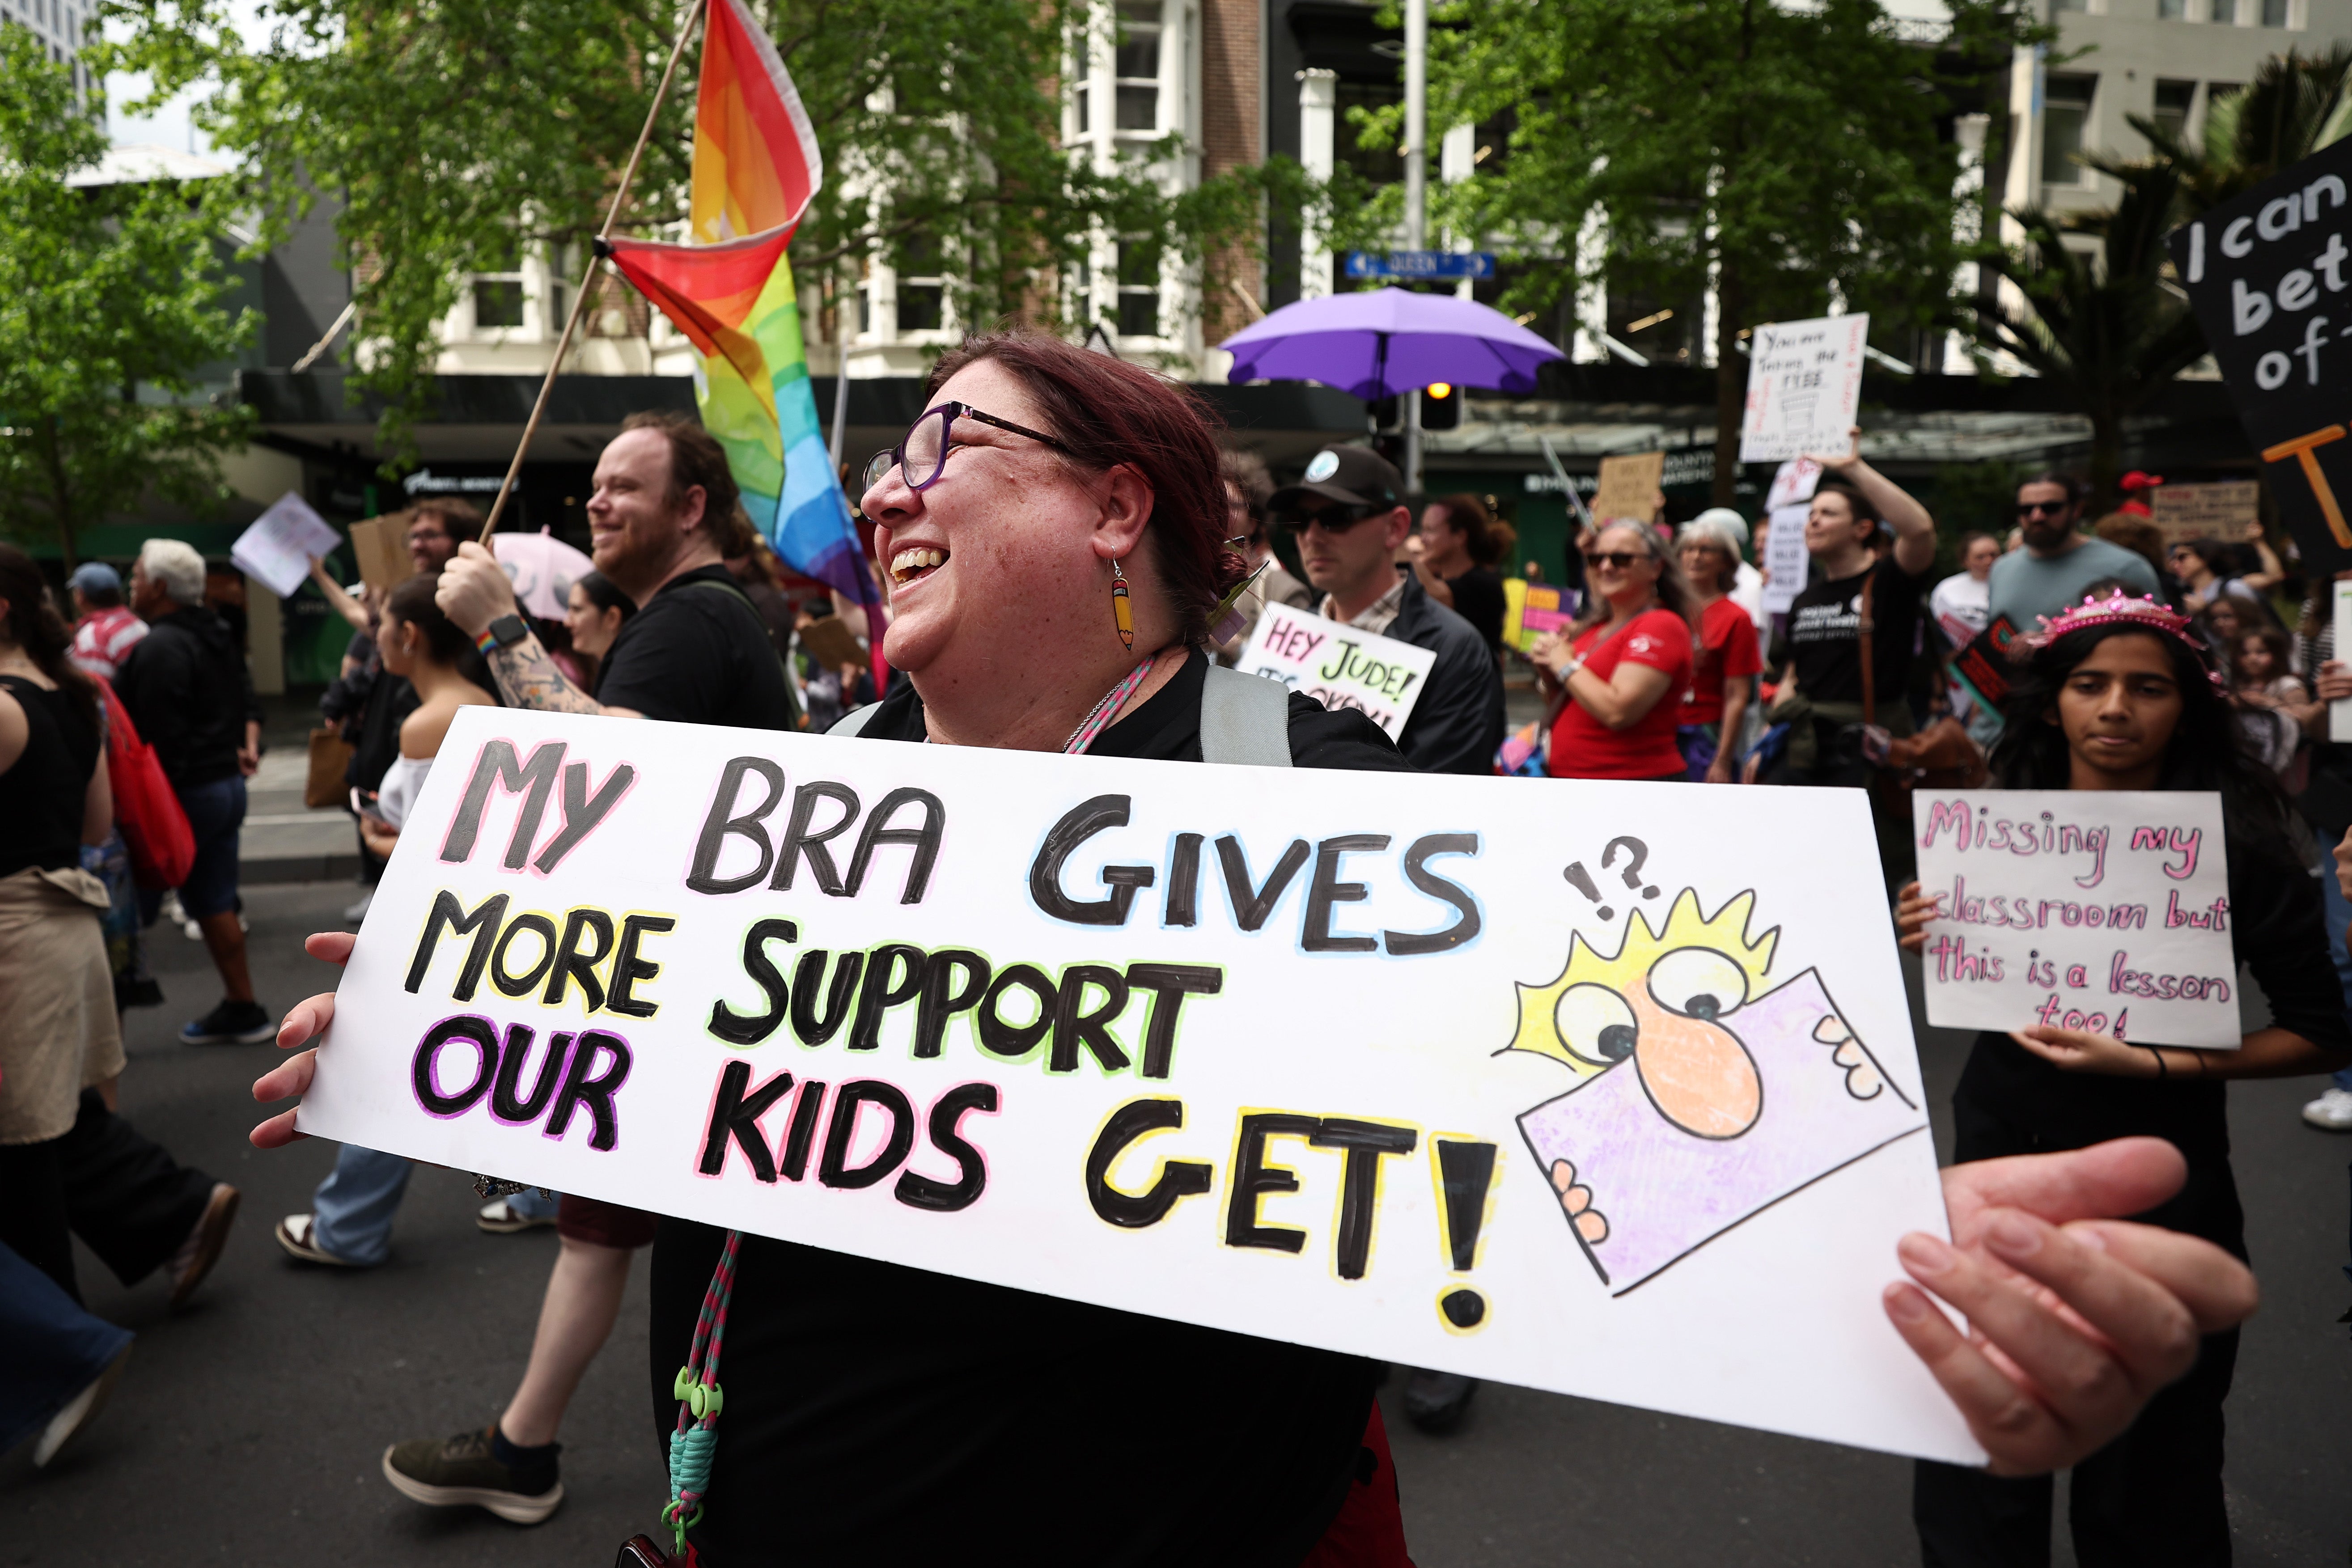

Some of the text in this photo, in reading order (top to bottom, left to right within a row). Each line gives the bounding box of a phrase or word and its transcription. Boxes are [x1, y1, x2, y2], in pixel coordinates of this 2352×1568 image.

[2186, 173, 2347, 283] I can
[2254, 315, 2329, 391] of
[1265, 616, 1419, 703] HEY JUDE!
[436, 739, 1482, 956] MY BRA GIVES
[1920, 798, 2202, 889] Missing my
[1932, 875, 2230, 932] classroom but
[404, 889, 1223, 1080] MORE SUPPORT
[1929, 935, 2230, 1003] this is a lesson
[2035, 993, 2129, 1040] too!
[412, 1014, 1498, 1329] OUR KIDS GET!
